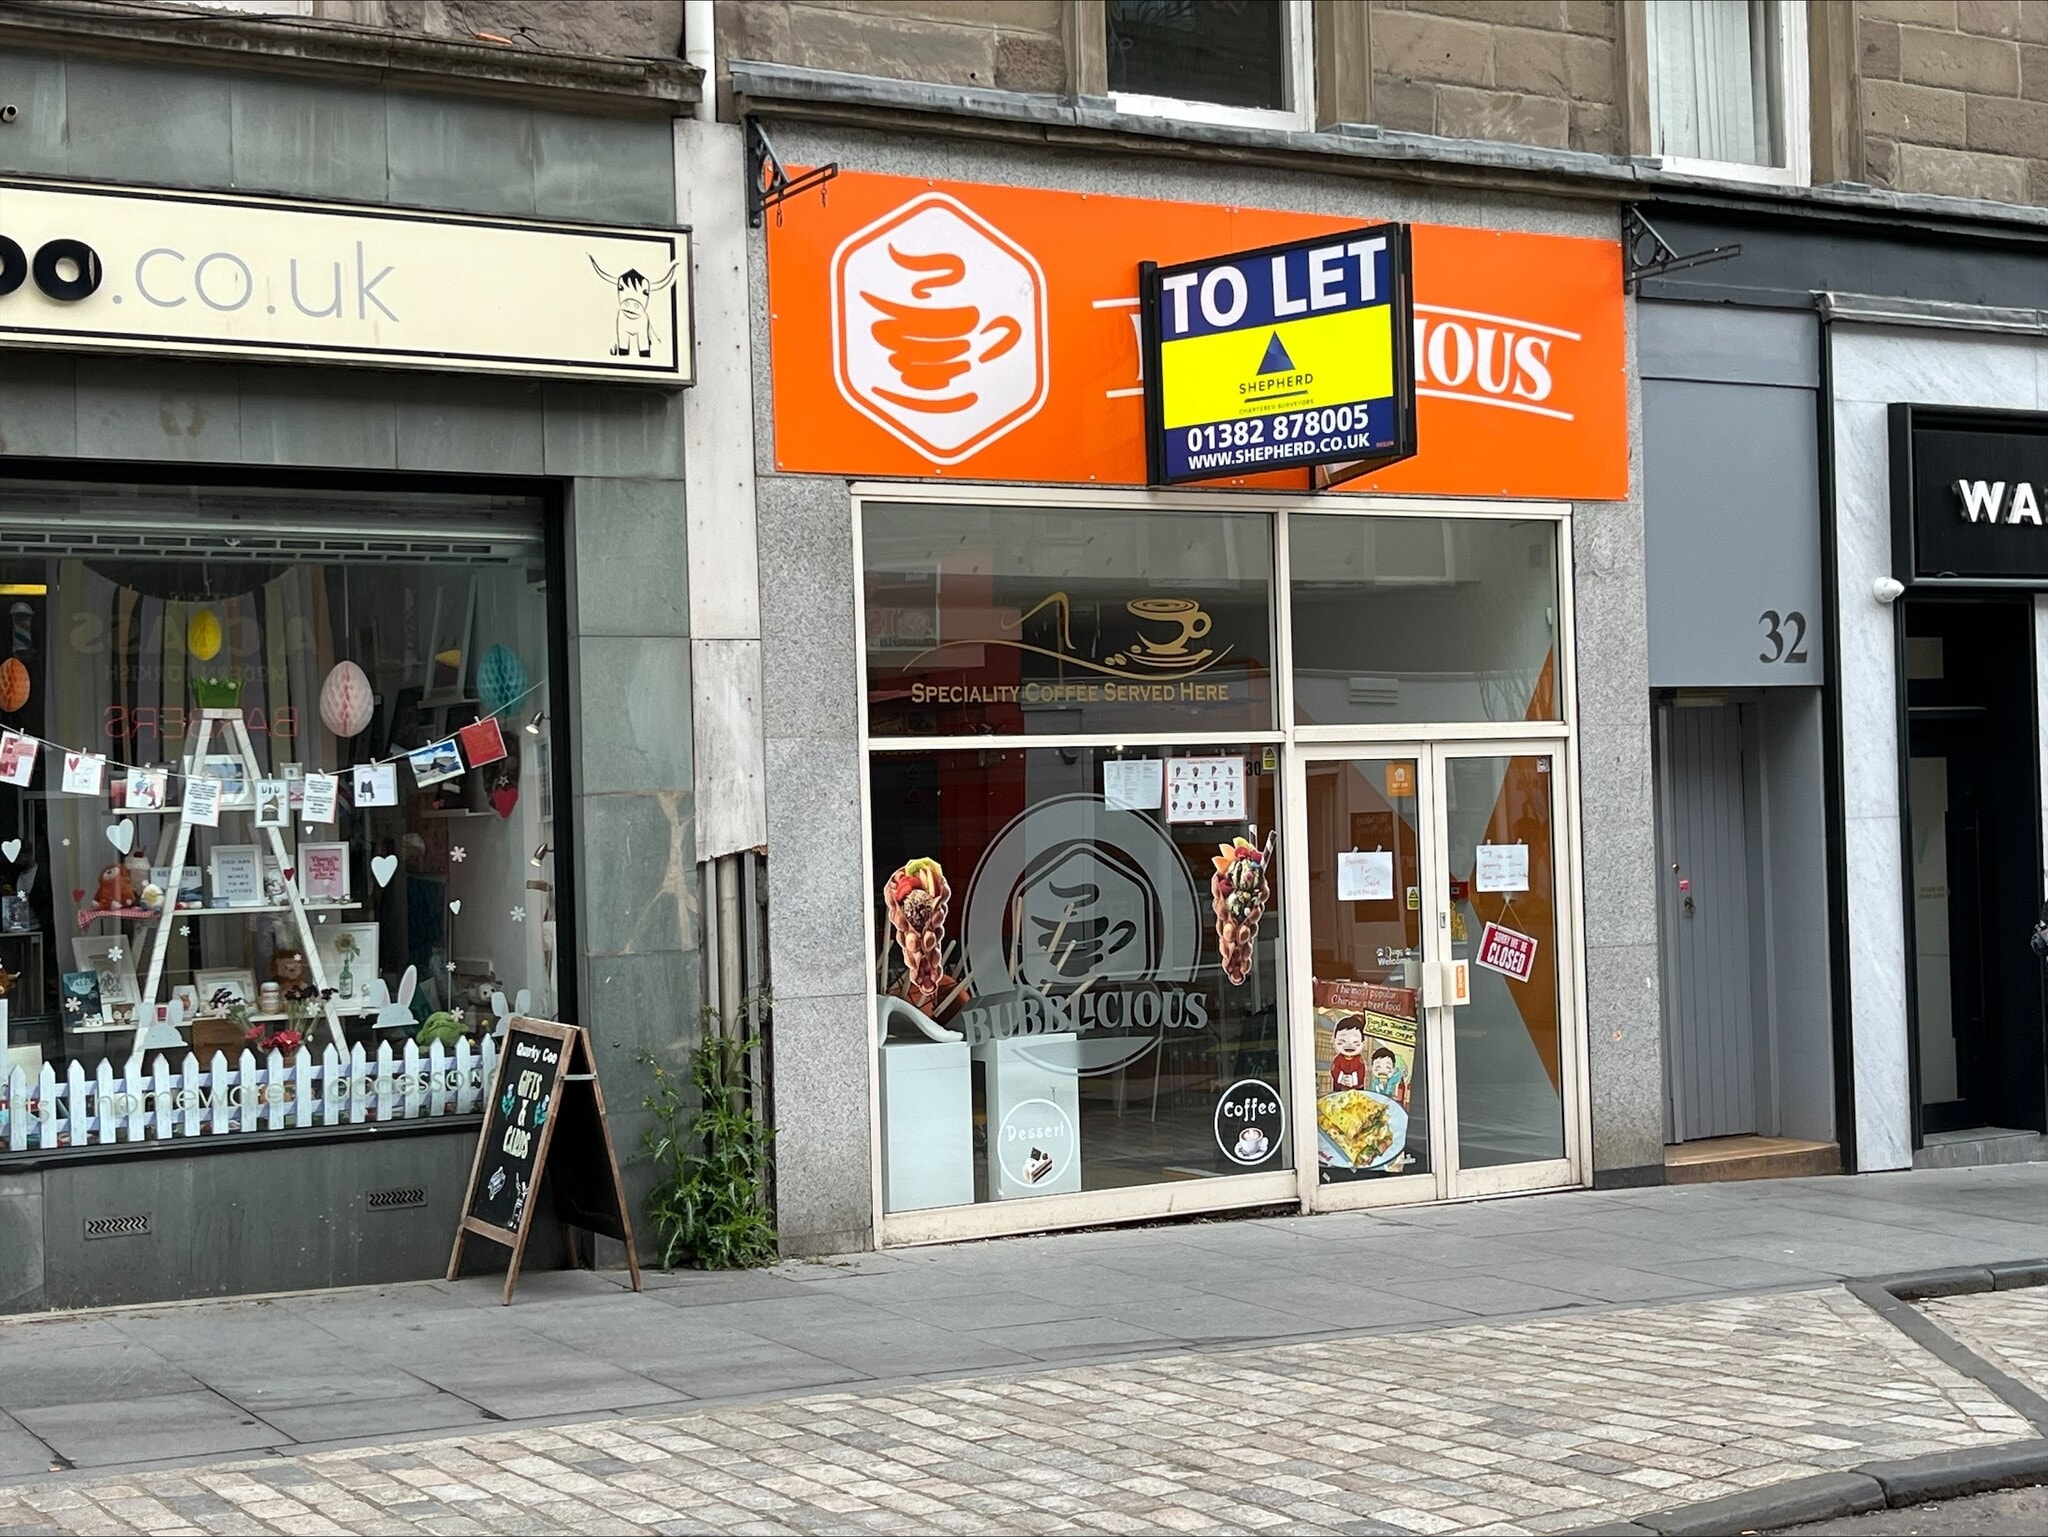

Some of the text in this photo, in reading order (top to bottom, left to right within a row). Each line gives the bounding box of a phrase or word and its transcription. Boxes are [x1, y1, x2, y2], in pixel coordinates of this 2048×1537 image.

[1162, 236, 1388, 335] TO LET
[1239, 373, 1314, 395] SHEPHERD
[1239, 398, 1314, 415] CHARTERED SURVEYORS
[1187, 404, 1369, 452] 01382 878005
[1187, 432, 1370, 470] WWW.SHEPHERD.CO.UK
[1955, 479, 2043, 526] WA
[1758, 609, 1808, 664] 32
[1246, 761, 1261, 776] 30
[1487, 942, 1526, 974] CLOSED
[1331, 994, 1361, 1007] Chinese
[1362, 999, 1384, 1009] street
[1369, 989, 1397, 1001] popular
[961, 990, 1208, 1048] BUBBLICIOUS
[517, 1069, 543, 1101] GIFTS
